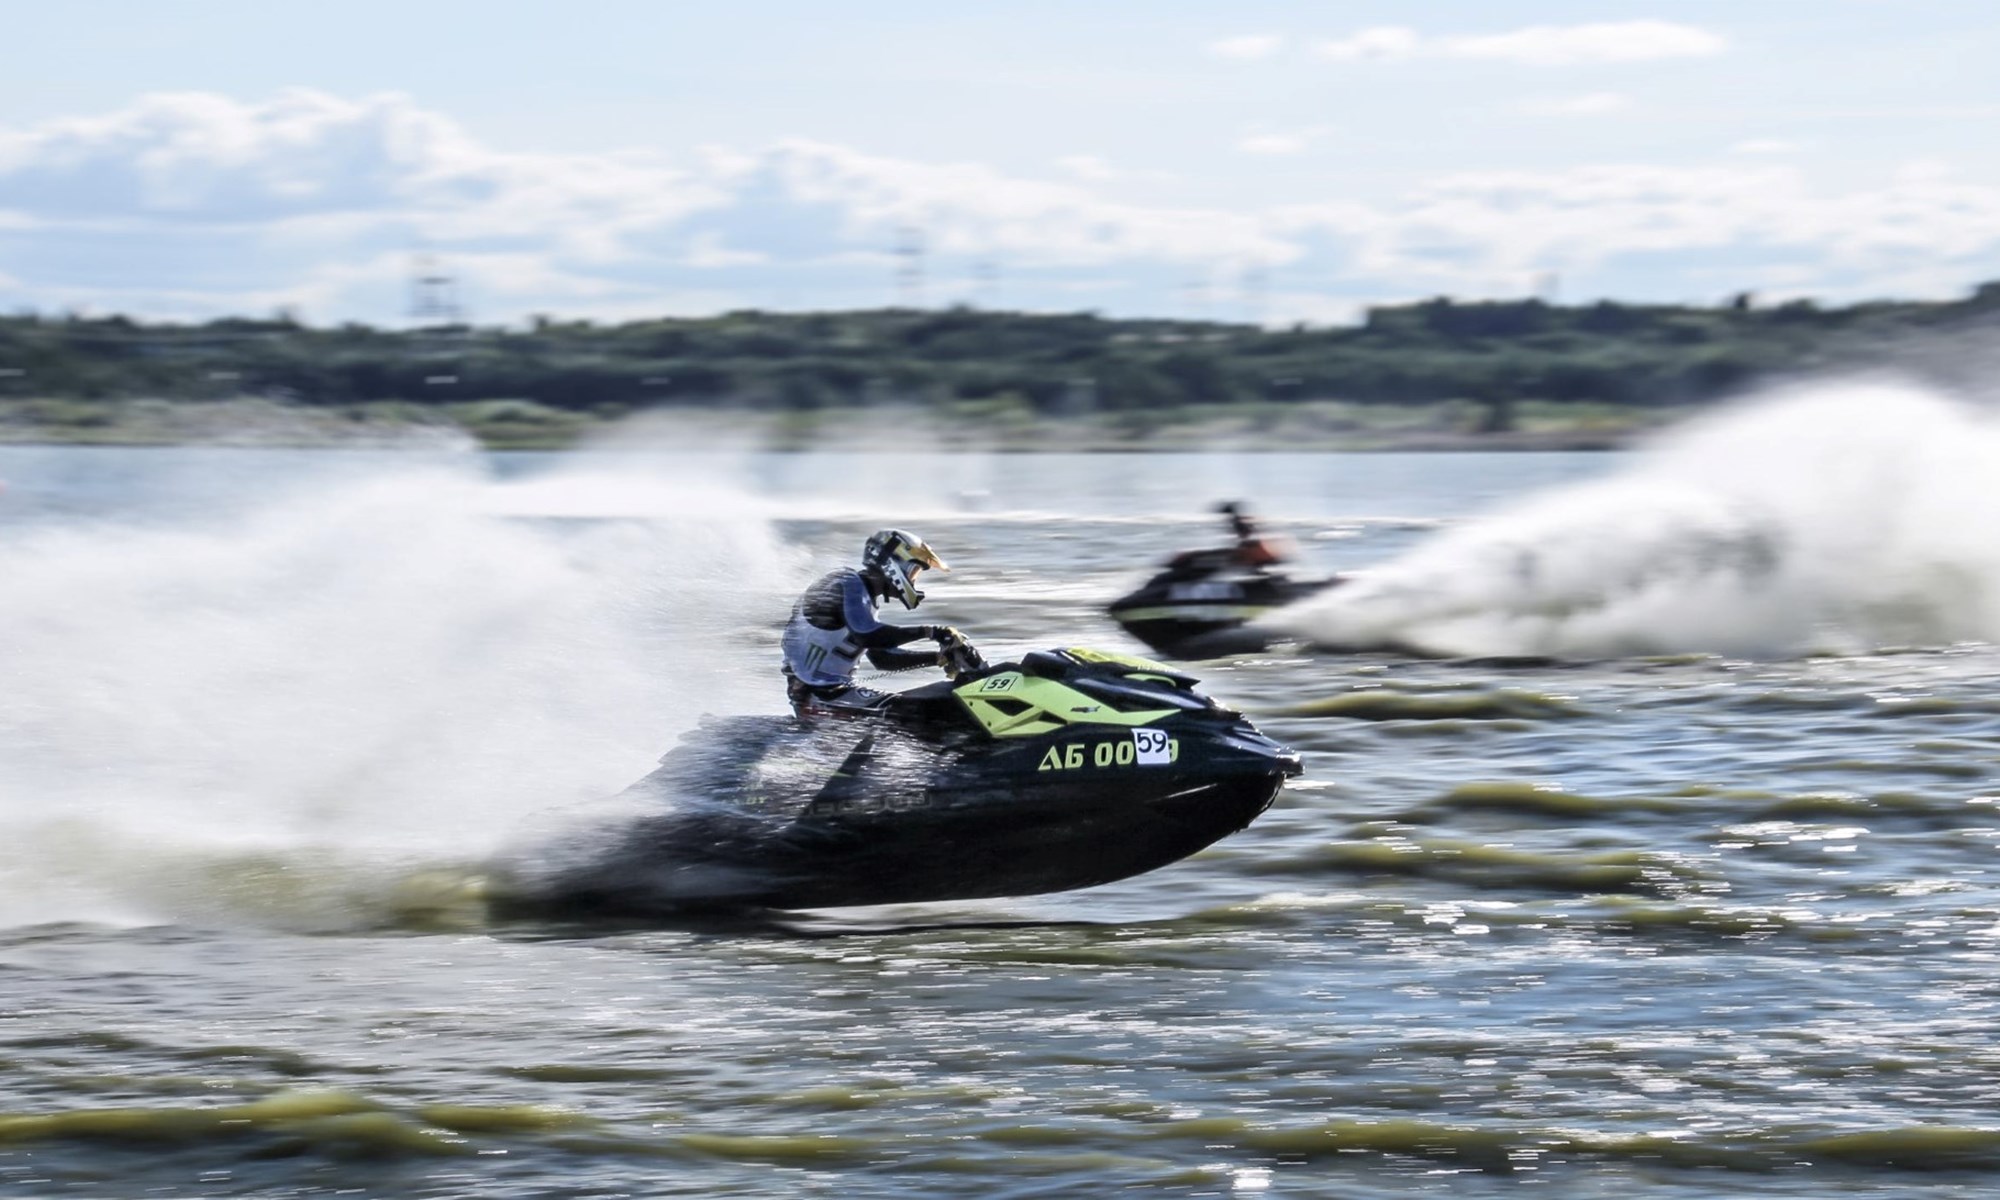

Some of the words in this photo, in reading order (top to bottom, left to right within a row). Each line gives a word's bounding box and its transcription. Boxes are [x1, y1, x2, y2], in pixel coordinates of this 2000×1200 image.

[986, 678, 1011, 689] 59
[1094, 738, 1179, 767] 00
[1136, 732, 1167, 753] 59
